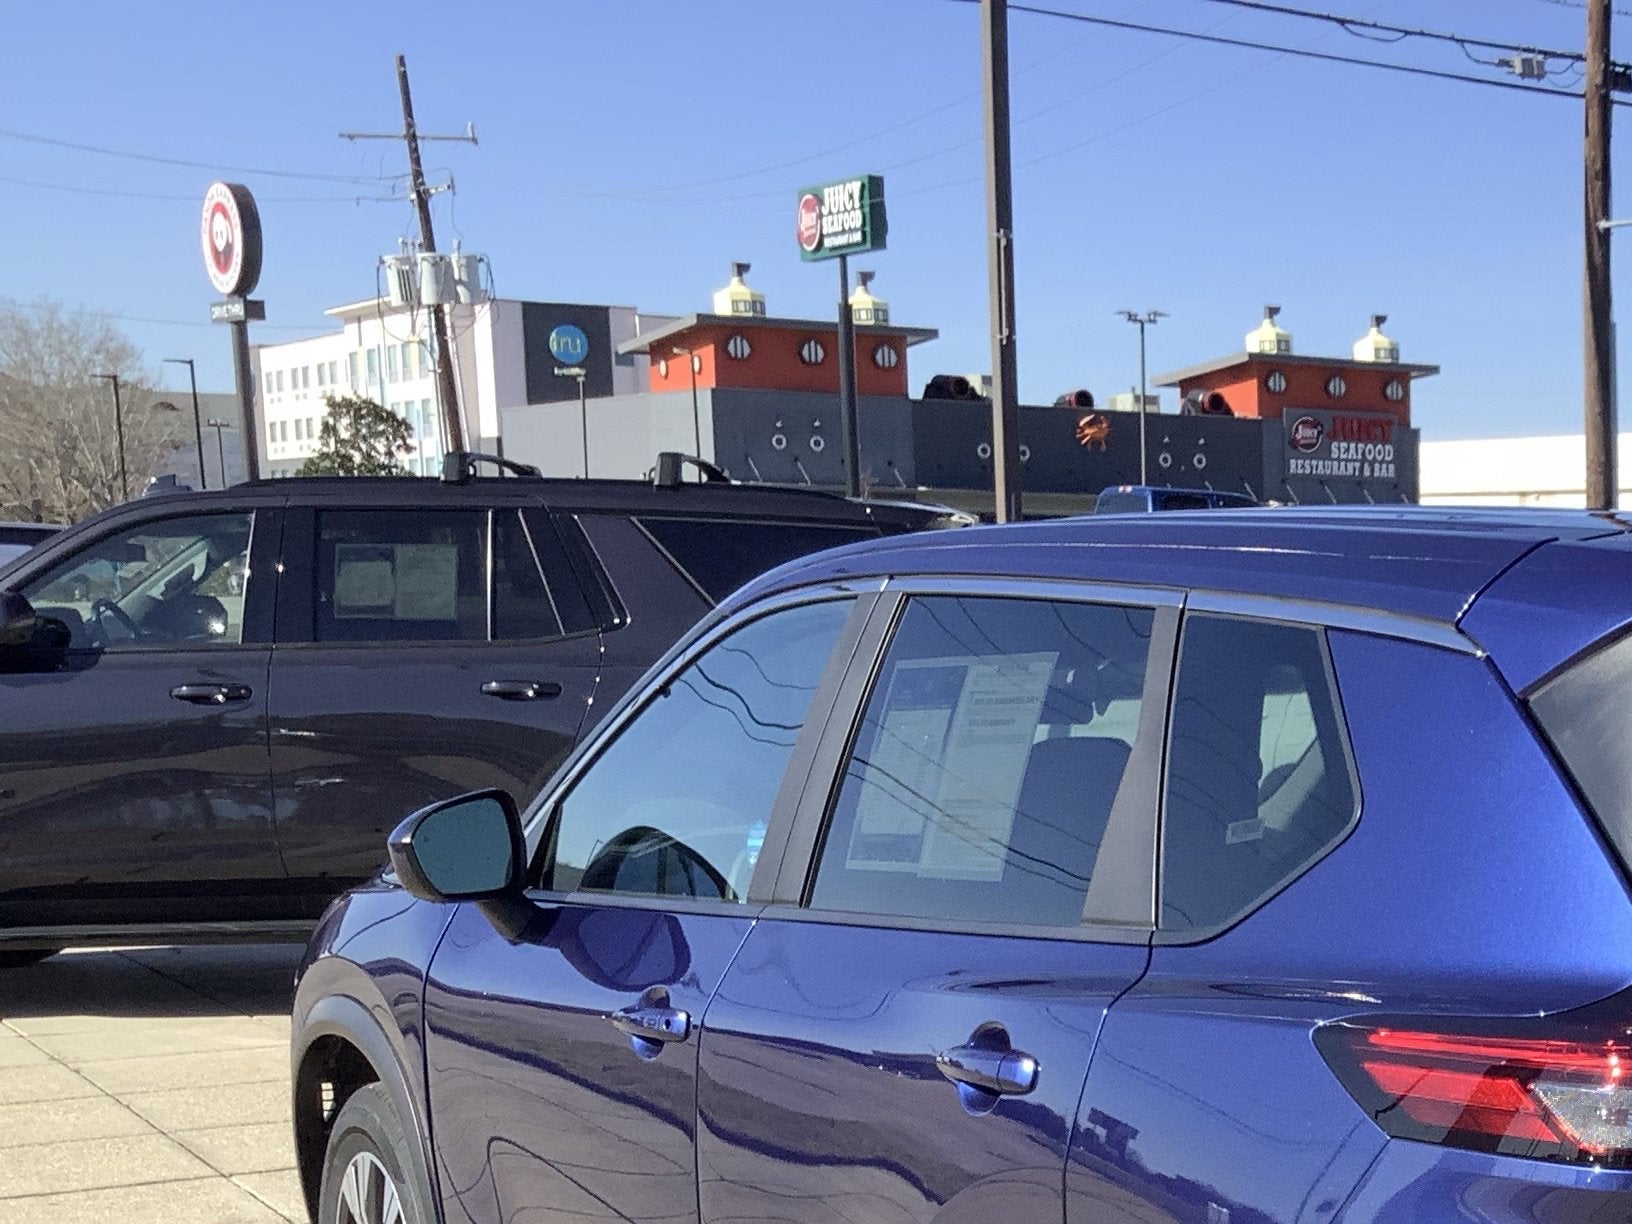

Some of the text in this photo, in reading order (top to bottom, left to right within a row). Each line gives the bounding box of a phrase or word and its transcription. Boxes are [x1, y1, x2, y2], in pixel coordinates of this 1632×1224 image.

[821, 181, 861, 215] JUICY
[822, 209, 862, 235] SEAFOOD
[1331, 442, 1394, 461] SEAFOOD
[1289, 459, 1395, 477] RESTAURANT & BAR
